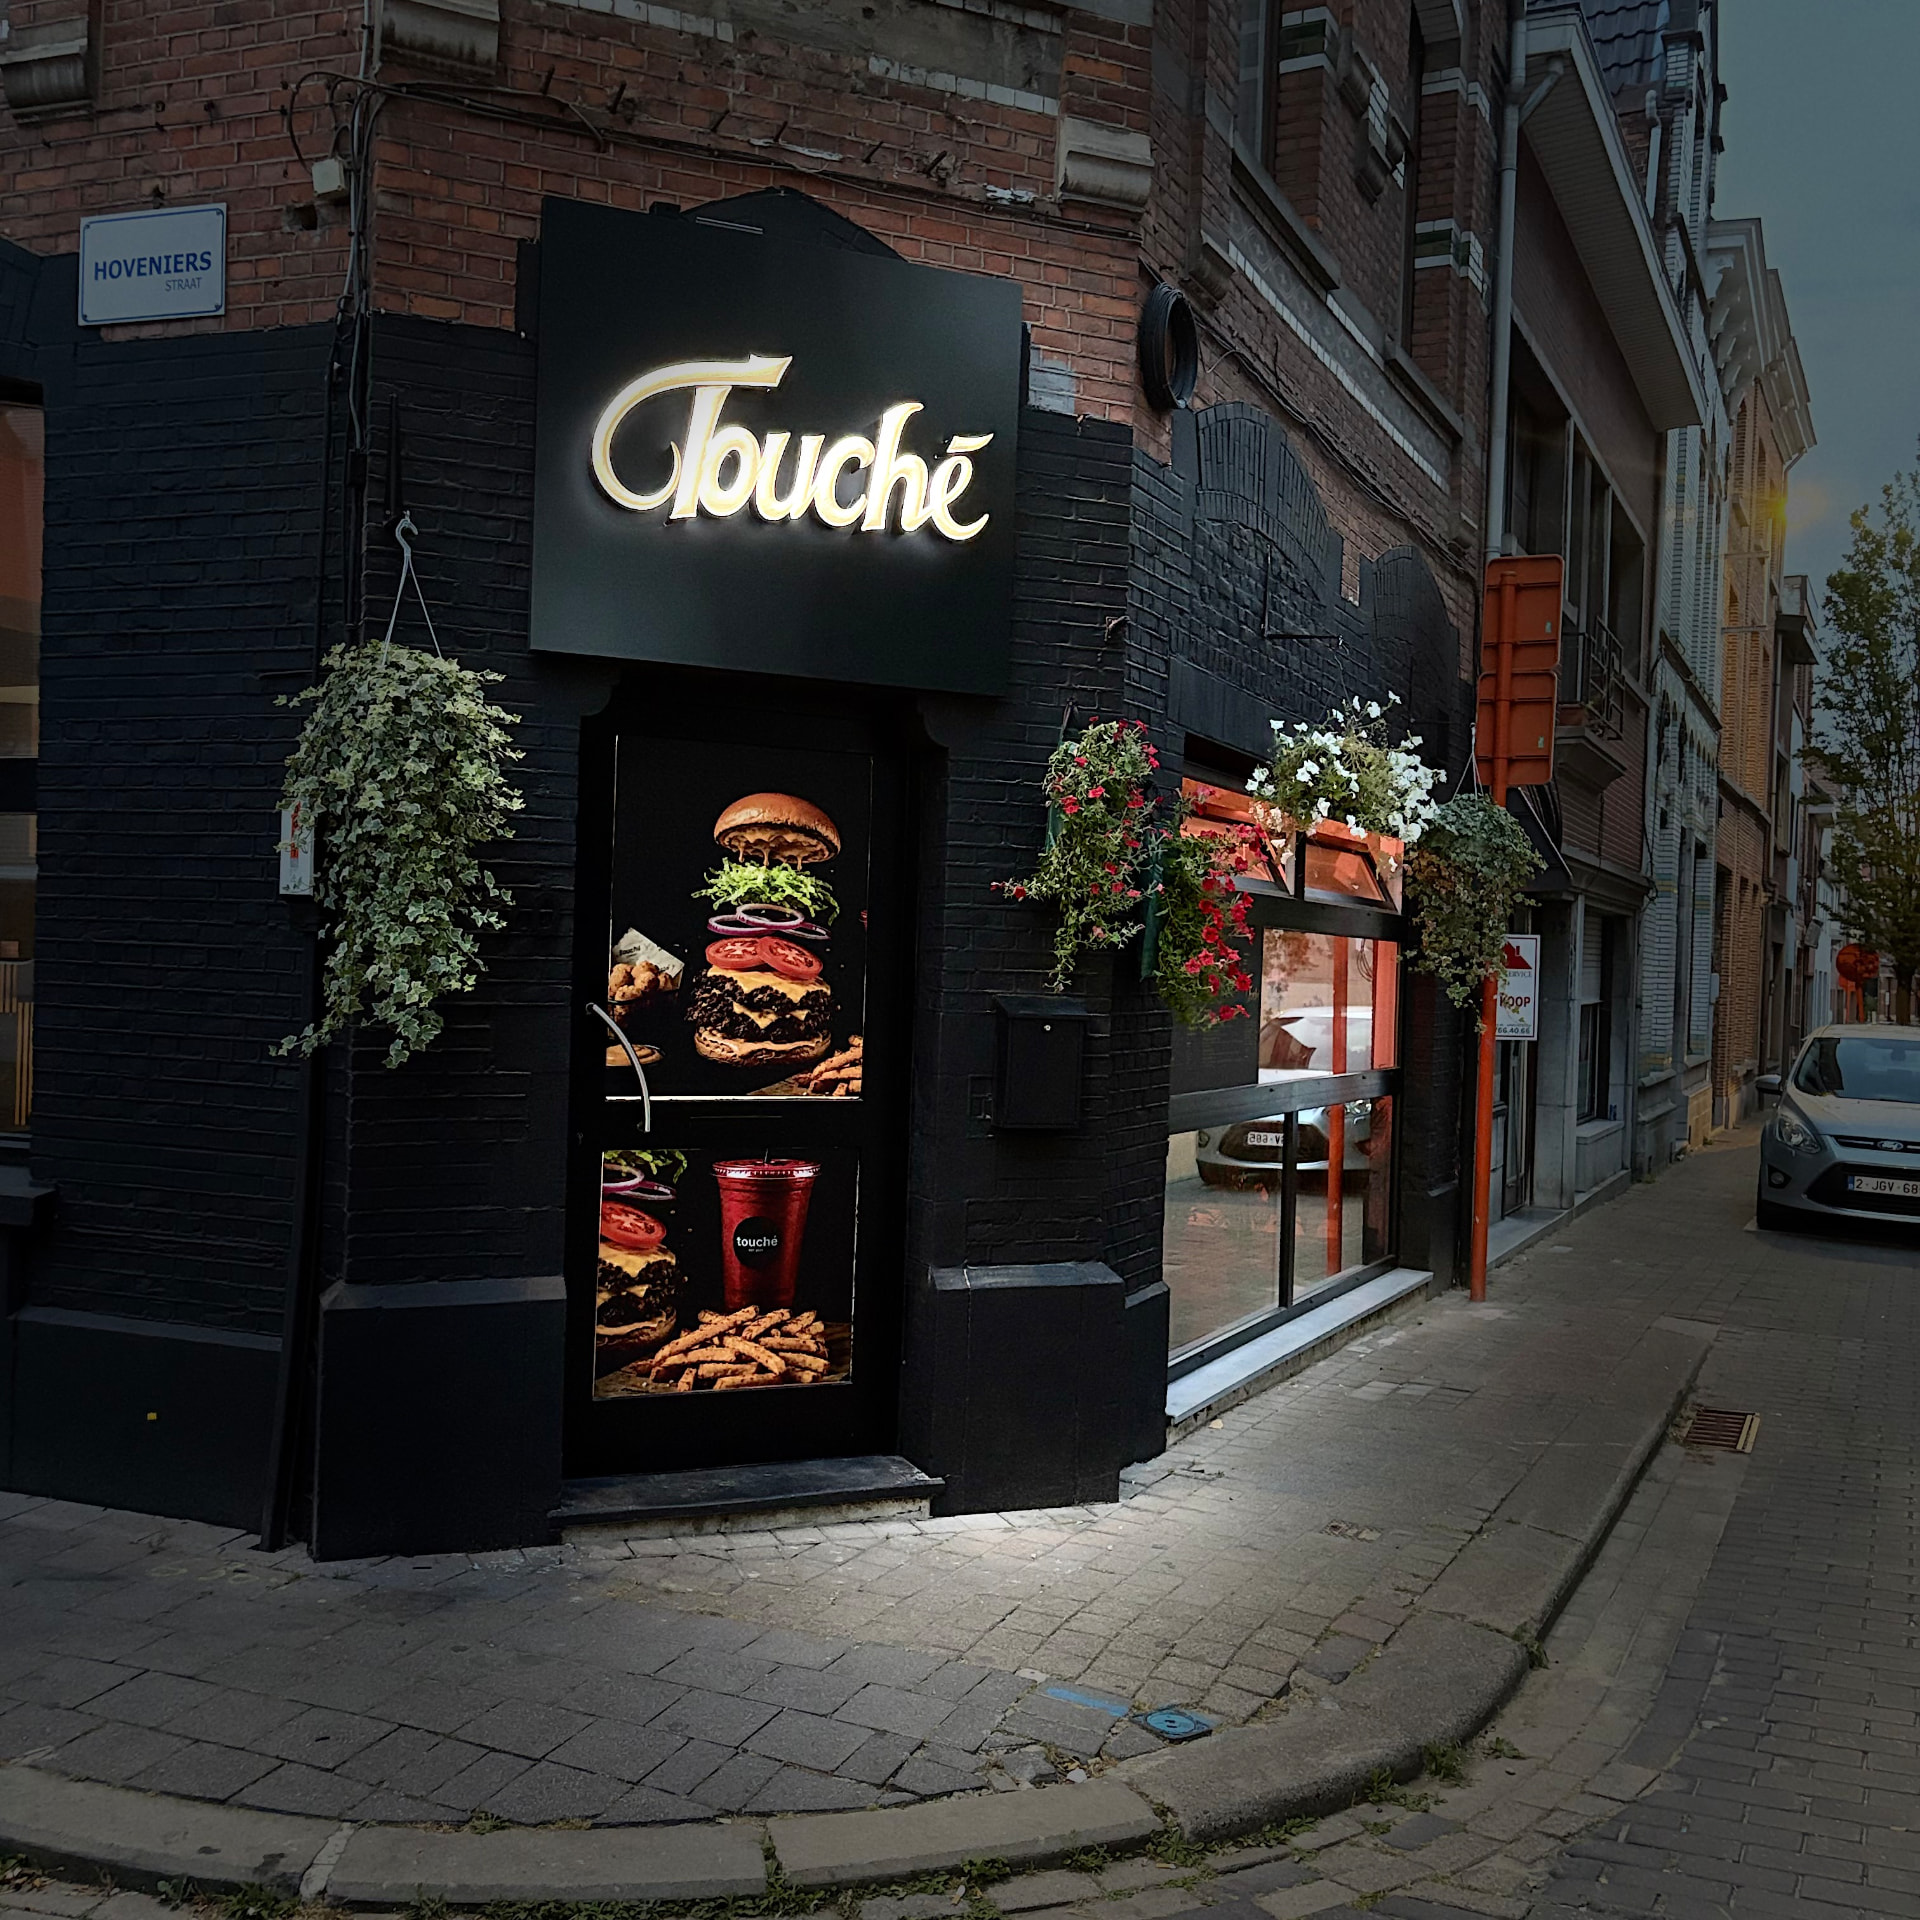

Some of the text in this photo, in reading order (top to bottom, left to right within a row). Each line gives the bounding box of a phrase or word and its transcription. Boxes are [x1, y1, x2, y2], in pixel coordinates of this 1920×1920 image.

[94, 251, 212, 281] HOVENIERS
[165, 277, 202, 292] STRAAT
[591, 354, 994, 542] Touché
[1508, 970, 1532, 978] ERVICE
[736, 1235, 778, 1247] touché
